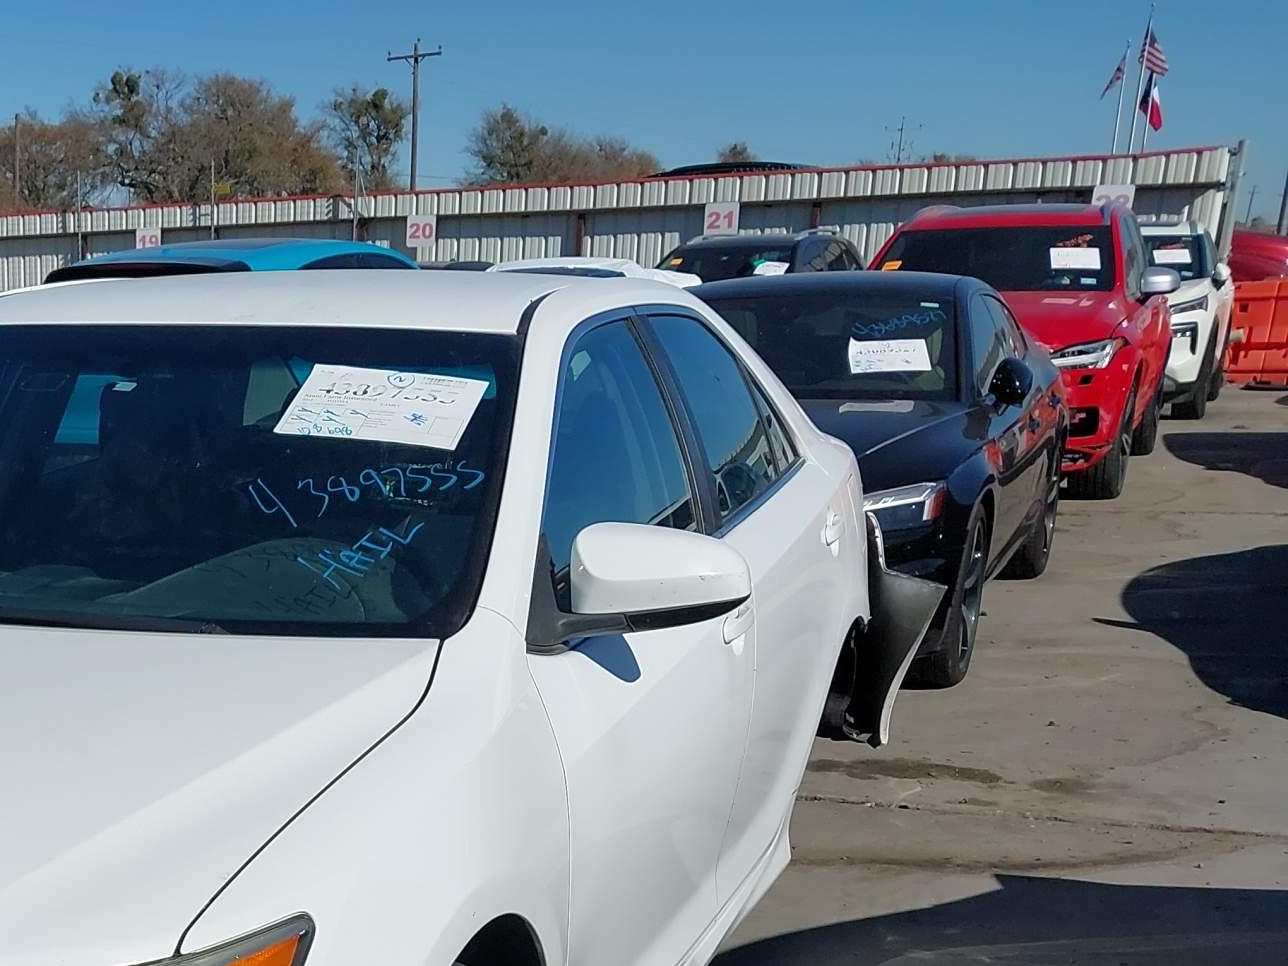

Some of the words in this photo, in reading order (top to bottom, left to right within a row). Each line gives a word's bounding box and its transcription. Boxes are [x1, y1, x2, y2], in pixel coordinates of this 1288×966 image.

[706, 210, 734, 230] 21
[409, 222, 433, 240] 20
[139, 235, 159, 248] 19
